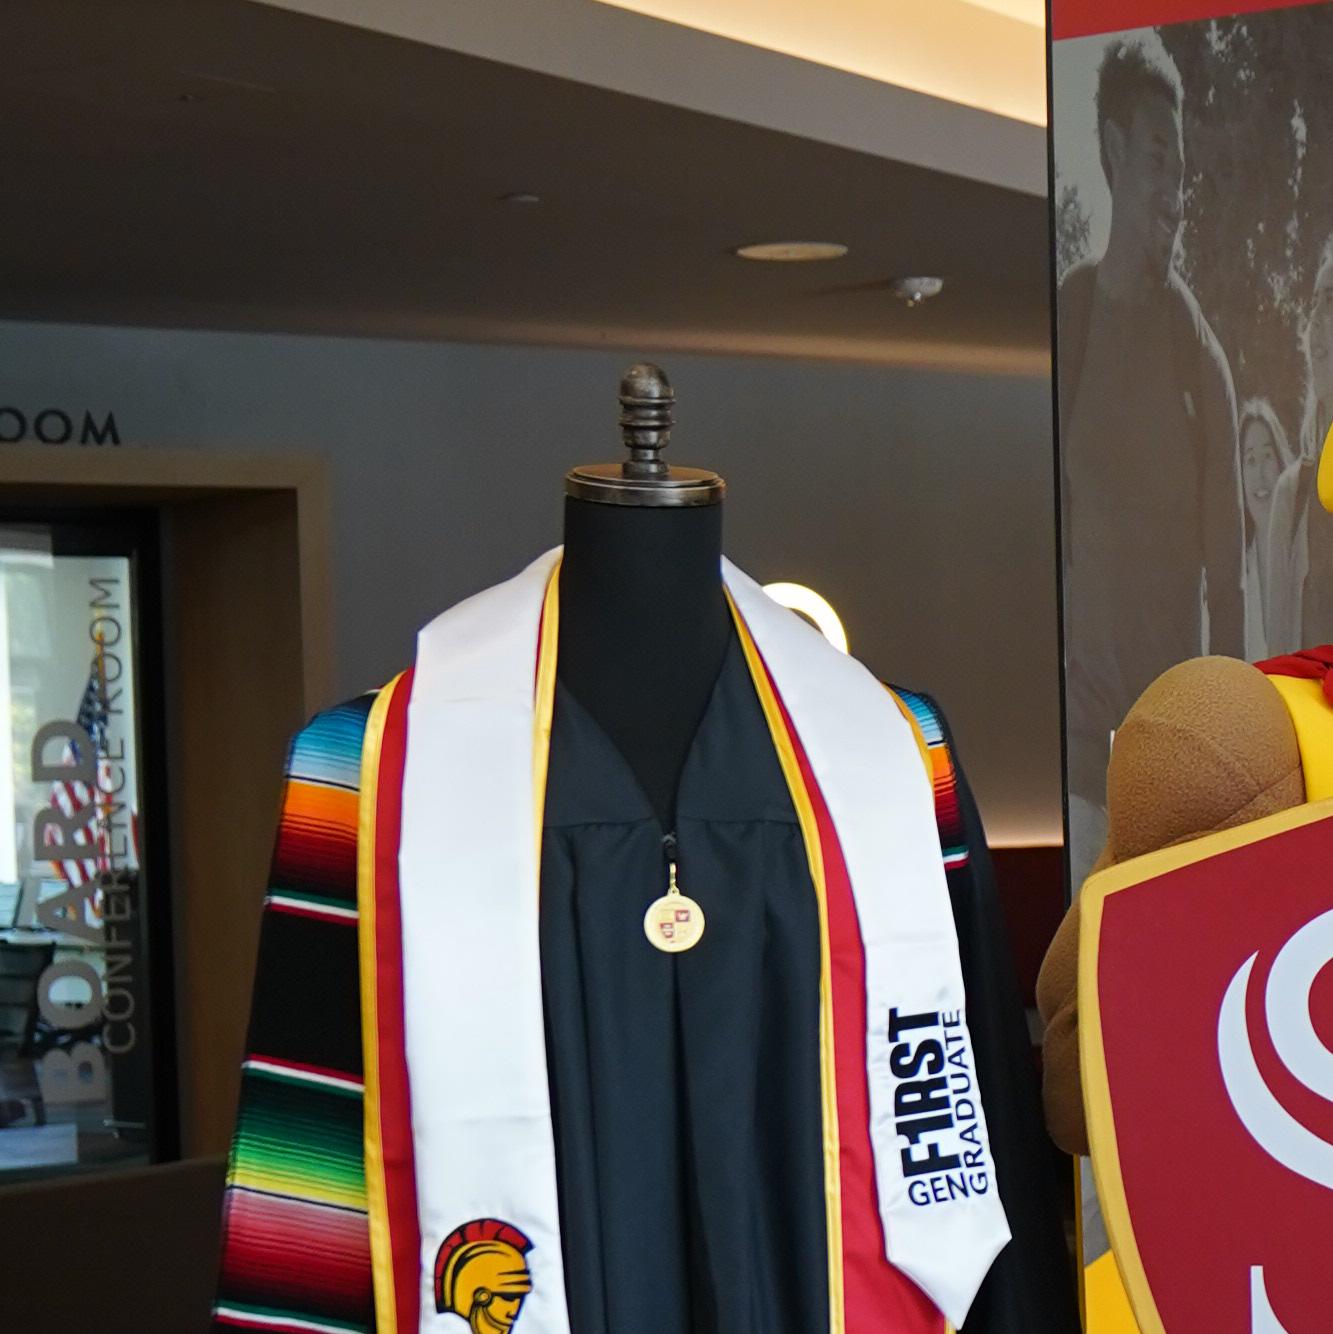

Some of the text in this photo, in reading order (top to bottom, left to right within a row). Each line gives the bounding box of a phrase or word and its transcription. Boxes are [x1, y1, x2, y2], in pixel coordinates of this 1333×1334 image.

[31, 718, 113, 1108] BOARD
[89, 577, 136, 1055] CONFERENCE ROOM
[907, 1171, 970, 1207] GEN
[942, 1009, 989, 1195] GRADUATE
